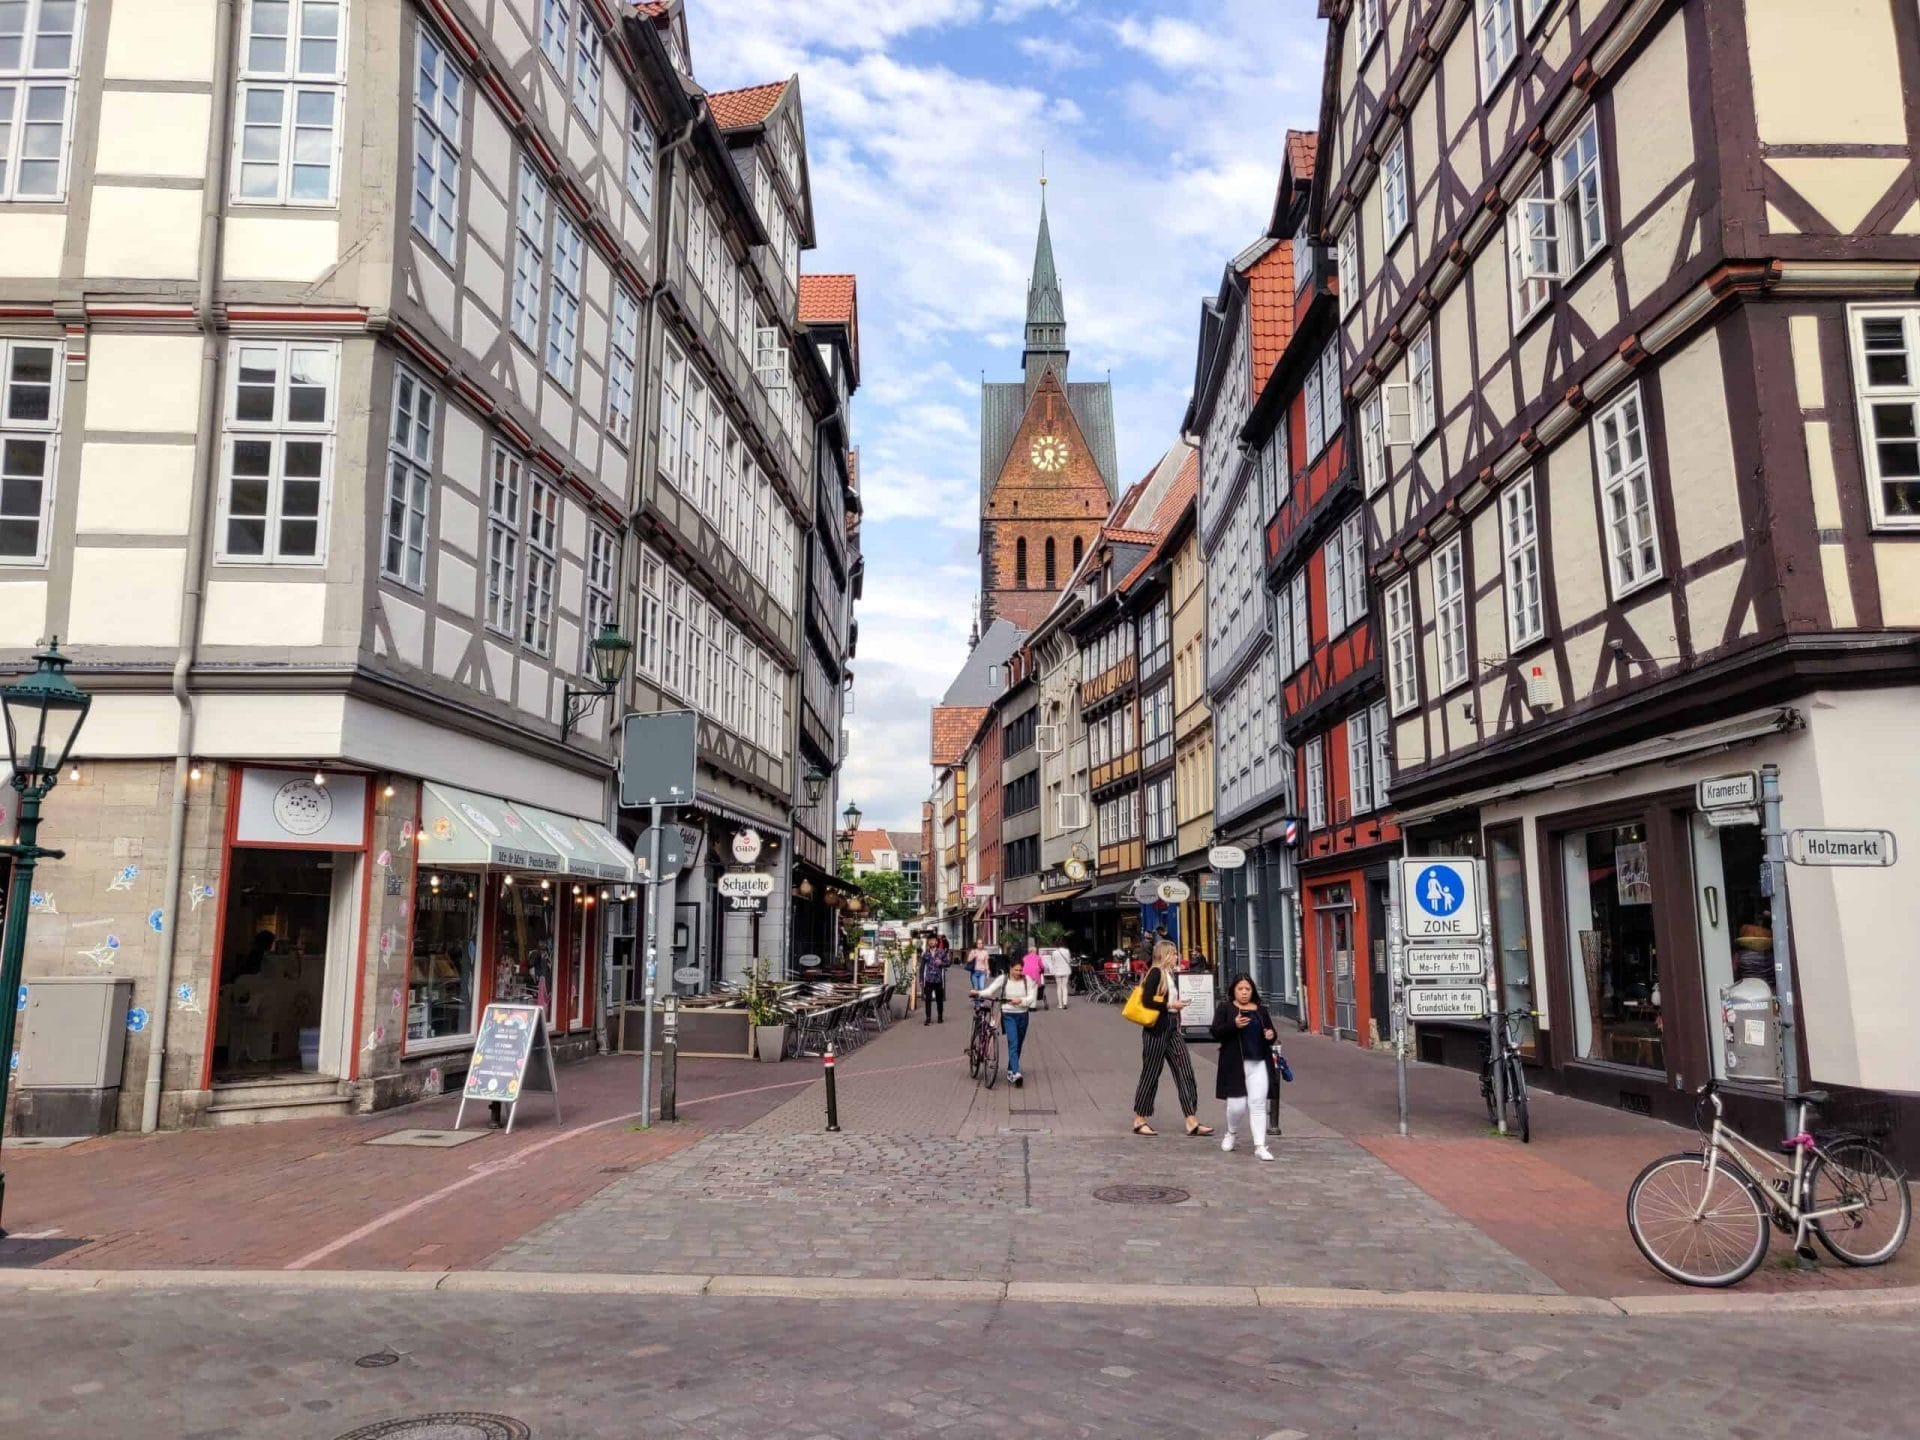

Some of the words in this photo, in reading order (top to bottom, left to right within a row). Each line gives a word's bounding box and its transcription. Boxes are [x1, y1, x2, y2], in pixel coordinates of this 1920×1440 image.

[1707, 781, 1748, 799] Kramerstr.
[1808, 839, 1878, 855] Holzmarkt
[1424, 920, 1461, 933] ZONE
[1412, 951, 1459, 961] Lieferverkehr
[1463, 951, 1475, 961] frei
[1419, 963, 1440, 972] Mo-Fr
[1450, 962, 1470, 972] 6-11h
[1420, 992, 1448, 1001] Einfahrt
[1452, 992, 1457, 1001] in
[1460, 992, 1472, 1001] die
[1416, 1002, 1460, 1012] Grundstücke
[1463, 1002, 1476, 1012] frei
